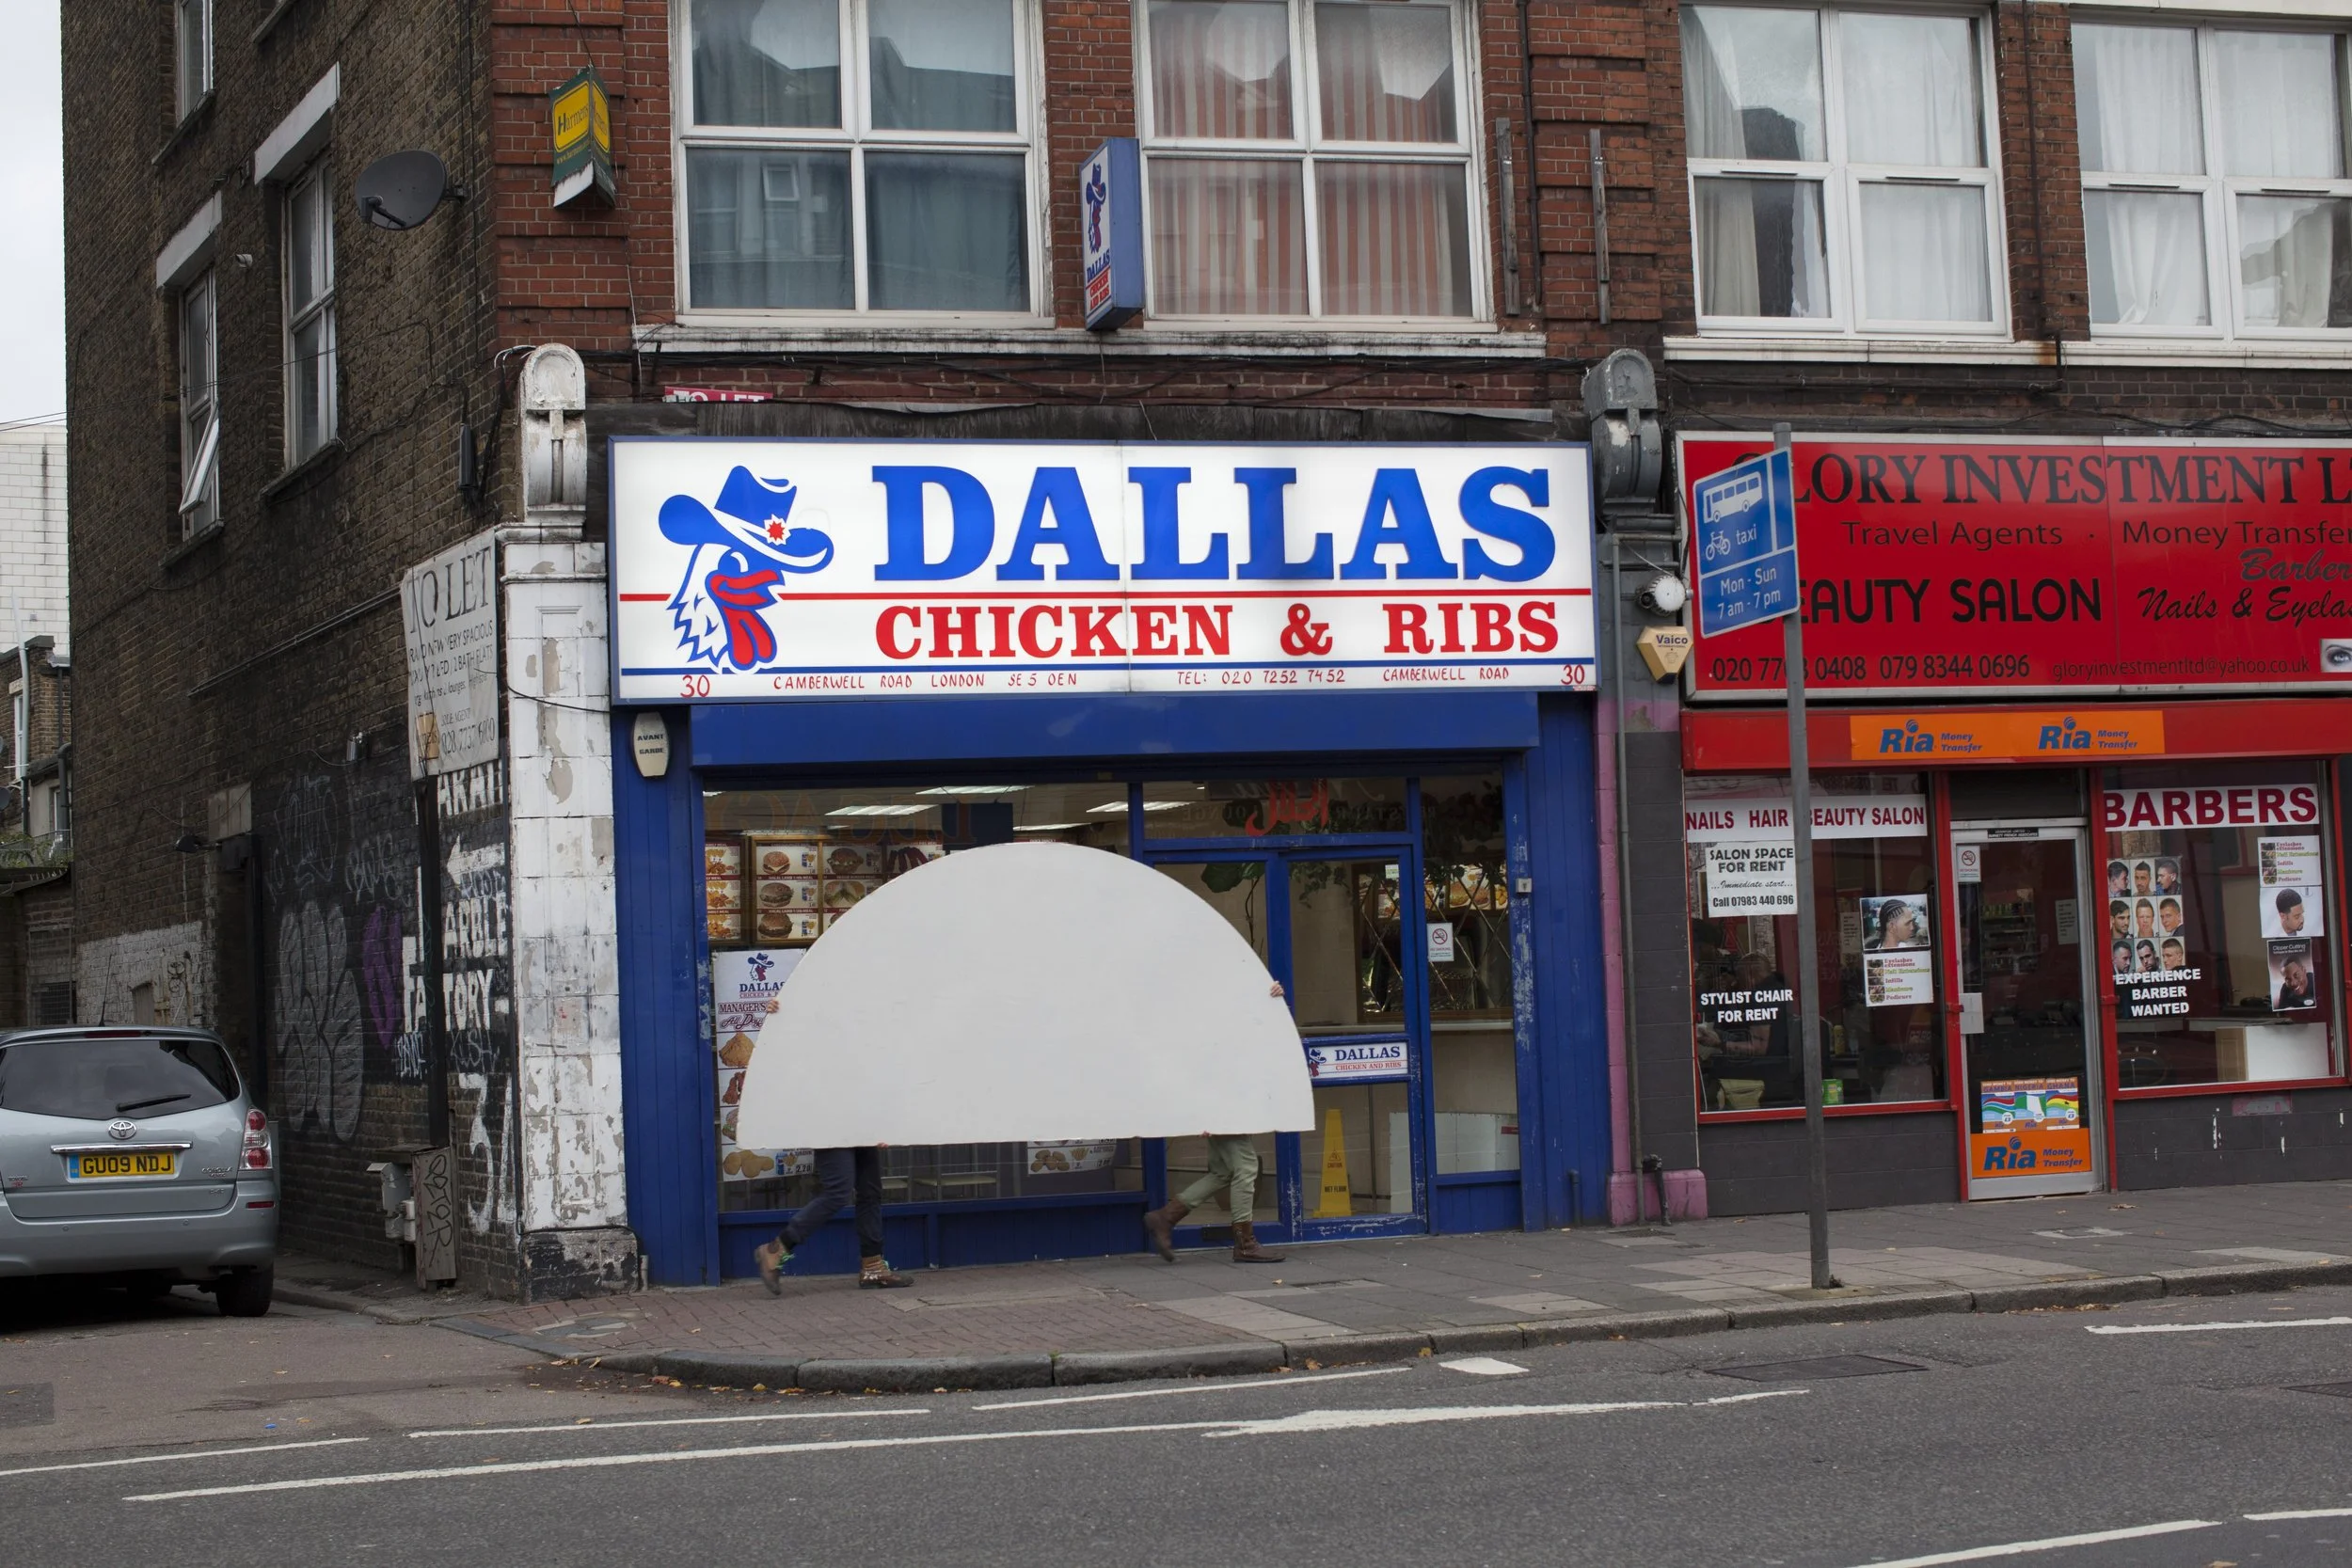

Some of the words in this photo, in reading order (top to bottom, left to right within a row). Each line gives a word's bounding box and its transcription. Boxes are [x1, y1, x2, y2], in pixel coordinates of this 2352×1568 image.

[1087, 248, 1110, 280] DALLAS
[1940, 453, 2304, 505] INVESTMENT
[2317, 456, 2352, 505] L
[872, 465, 1556, 583] DALLAS
[1736, 524, 1757, 546] taxi
[1841, 521, 1939, 546] Travel
[1949, 522, 2062, 551] Agents
[2122, 521, 2229, 549] Money
[406, 568, 438, 634] TO
[445, 546, 492, 621] LET
[1721, 576, 1744, 596] Mon
[1755, 566, 1777, 585] Sun
[1718, 603, 1724, 621] 7
[1727, 600, 1744, 617] am
[1753, 593, 1761, 609] 7
[1764, 589, 1781, 610] pm
[1950, 578, 2102, 623] SALON
[2137, 586, 2218, 621] Nails
[2232, 587, 2252, 619] &
[463, 620, 493, 646] SPACIOUS
[875, 605, 1232, 660] CHICKEN
[1280, 603, 1333, 656] &
[1383, 601, 1559, 654] RIBS
[1178, 671, 1207, 685] TEL:
[1222, 671, 1252, 685] 020
[1263, 670, 1298, 685] 7252
[1308, 669, 1345, 683] 7452
[1383, 667, 1466, 683] CAMBERWELL
[1479, 667, 1510, 681] ROAD
[1561, 664, 1585, 686] 30
[1713, 658, 1752, 682] 020
[1816, 657, 1867, 681] 0408
[1880, 657, 1917, 681] 079
[1923, 656, 1974, 680] 8344
[1979, 655, 2030, 679] 0696
[2053, 655, 2311, 682] gloryinvestmentltd@yahoo.co.uk
[680, 673, 710, 699] 30
[773, 674, 865, 690] CAMBERWELL
[881, 673, 913, 689] ROAD
[931, 673, 985, 688] LONDON
[1879, 719, 1935, 753] Ria
[1941, 732, 1974, 743] Money
[2038, 716, 2091, 750] Ria
[2097, 729, 2129, 740] Money
[2097, 739, 2138, 751] Transfer
[1941, 743, 1983, 752] Transfer
[1686, 810, 1735, 831] NAILS
[1749, 808, 1789, 829] HAIR
[1871, 806, 1925, 826] SALON
[2104, 786, 2317, 829] BARBERS
[1709, 847, 1751, 862] SALON
[1755, 847, 1794, 860] SPACE
[1718, 861, 1746, 874] FOR
[1750, 860, 1786, 872] RENT
[1712, 896, 1730, 908] Call
[1731, 895, 1757, 907] 07983
[1758, 895, 1775, 906] 440
[1776, 895, 1794, 905] 696
[403, 936, 495, 1035] FATORY
[2115, 969, 2201, 985] EXPERIENCE
[1700, 990, 1752, 1006] STYLIST
[1755, 989, 1794, 1003] CHAIR
[2132, 986, 2187, 1001] BARBER
[1717, 1010, 1741, 1023] FOR
[1745, 1007, 1779, 1022] RENT
[2131, 1002, 2190, 1017] WANTED
[1334, 1046, 1401, 1061] DALLAS
[1336, 1063, 1367, 1071] CHICKEN
[83, 1156, 131, 1175] GU09
[136, 1154, 172, 1173] NDJ
[1983, 1136, 2038, 1171] Ria
[2042, 1148, 2074, 1157] Money
[2043, 1159, 2083, 1167] Transfer
